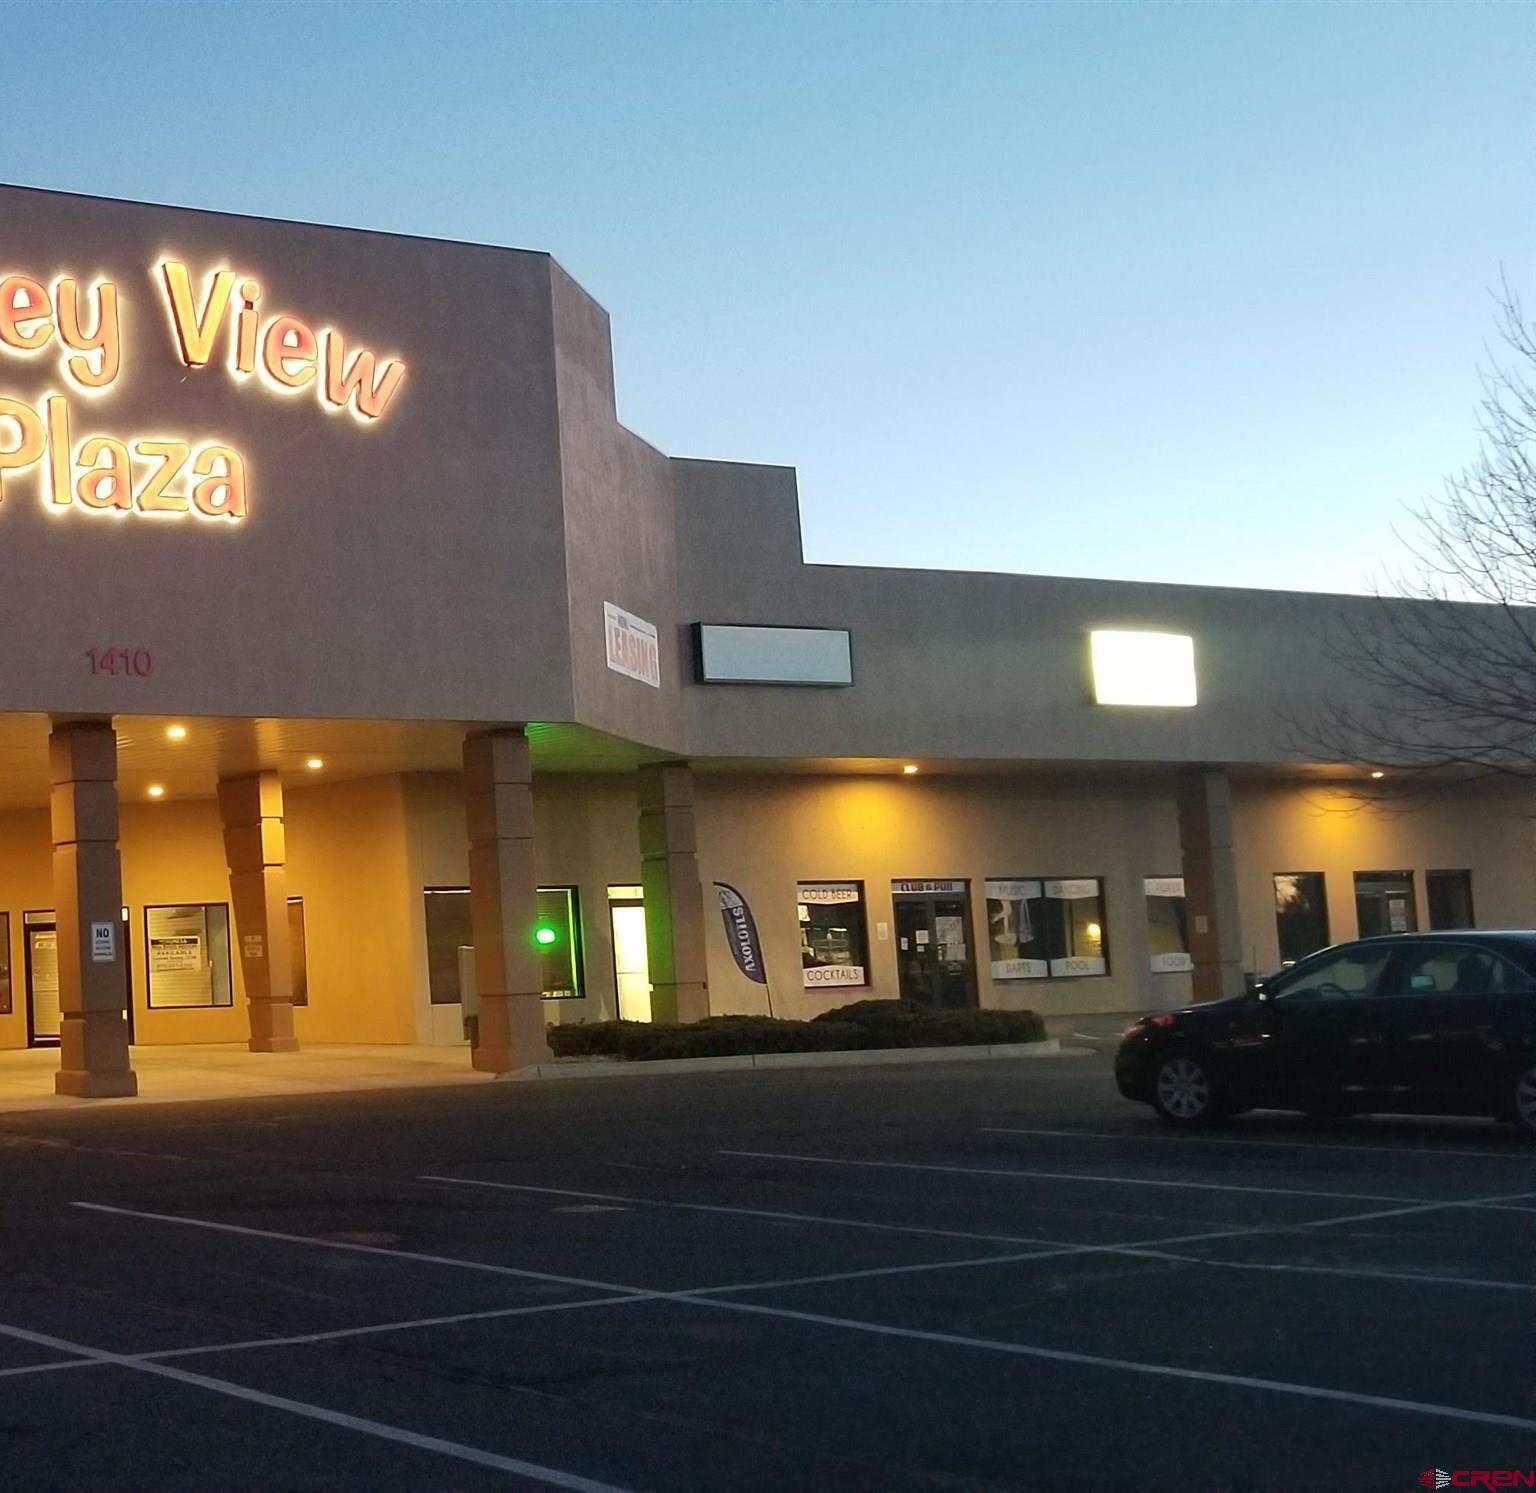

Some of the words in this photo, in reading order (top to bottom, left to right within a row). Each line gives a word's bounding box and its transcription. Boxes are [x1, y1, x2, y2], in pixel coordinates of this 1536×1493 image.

[161, 260, 406, 418] View
[85, 647, 156, 678] 1410
[802, 888, 828, 900] COLD
[96, 928, 110, 938] NO
[732, 907, 757, 971] AXOLOTLS
[807, 969, 859, 982] COCKTAILS
